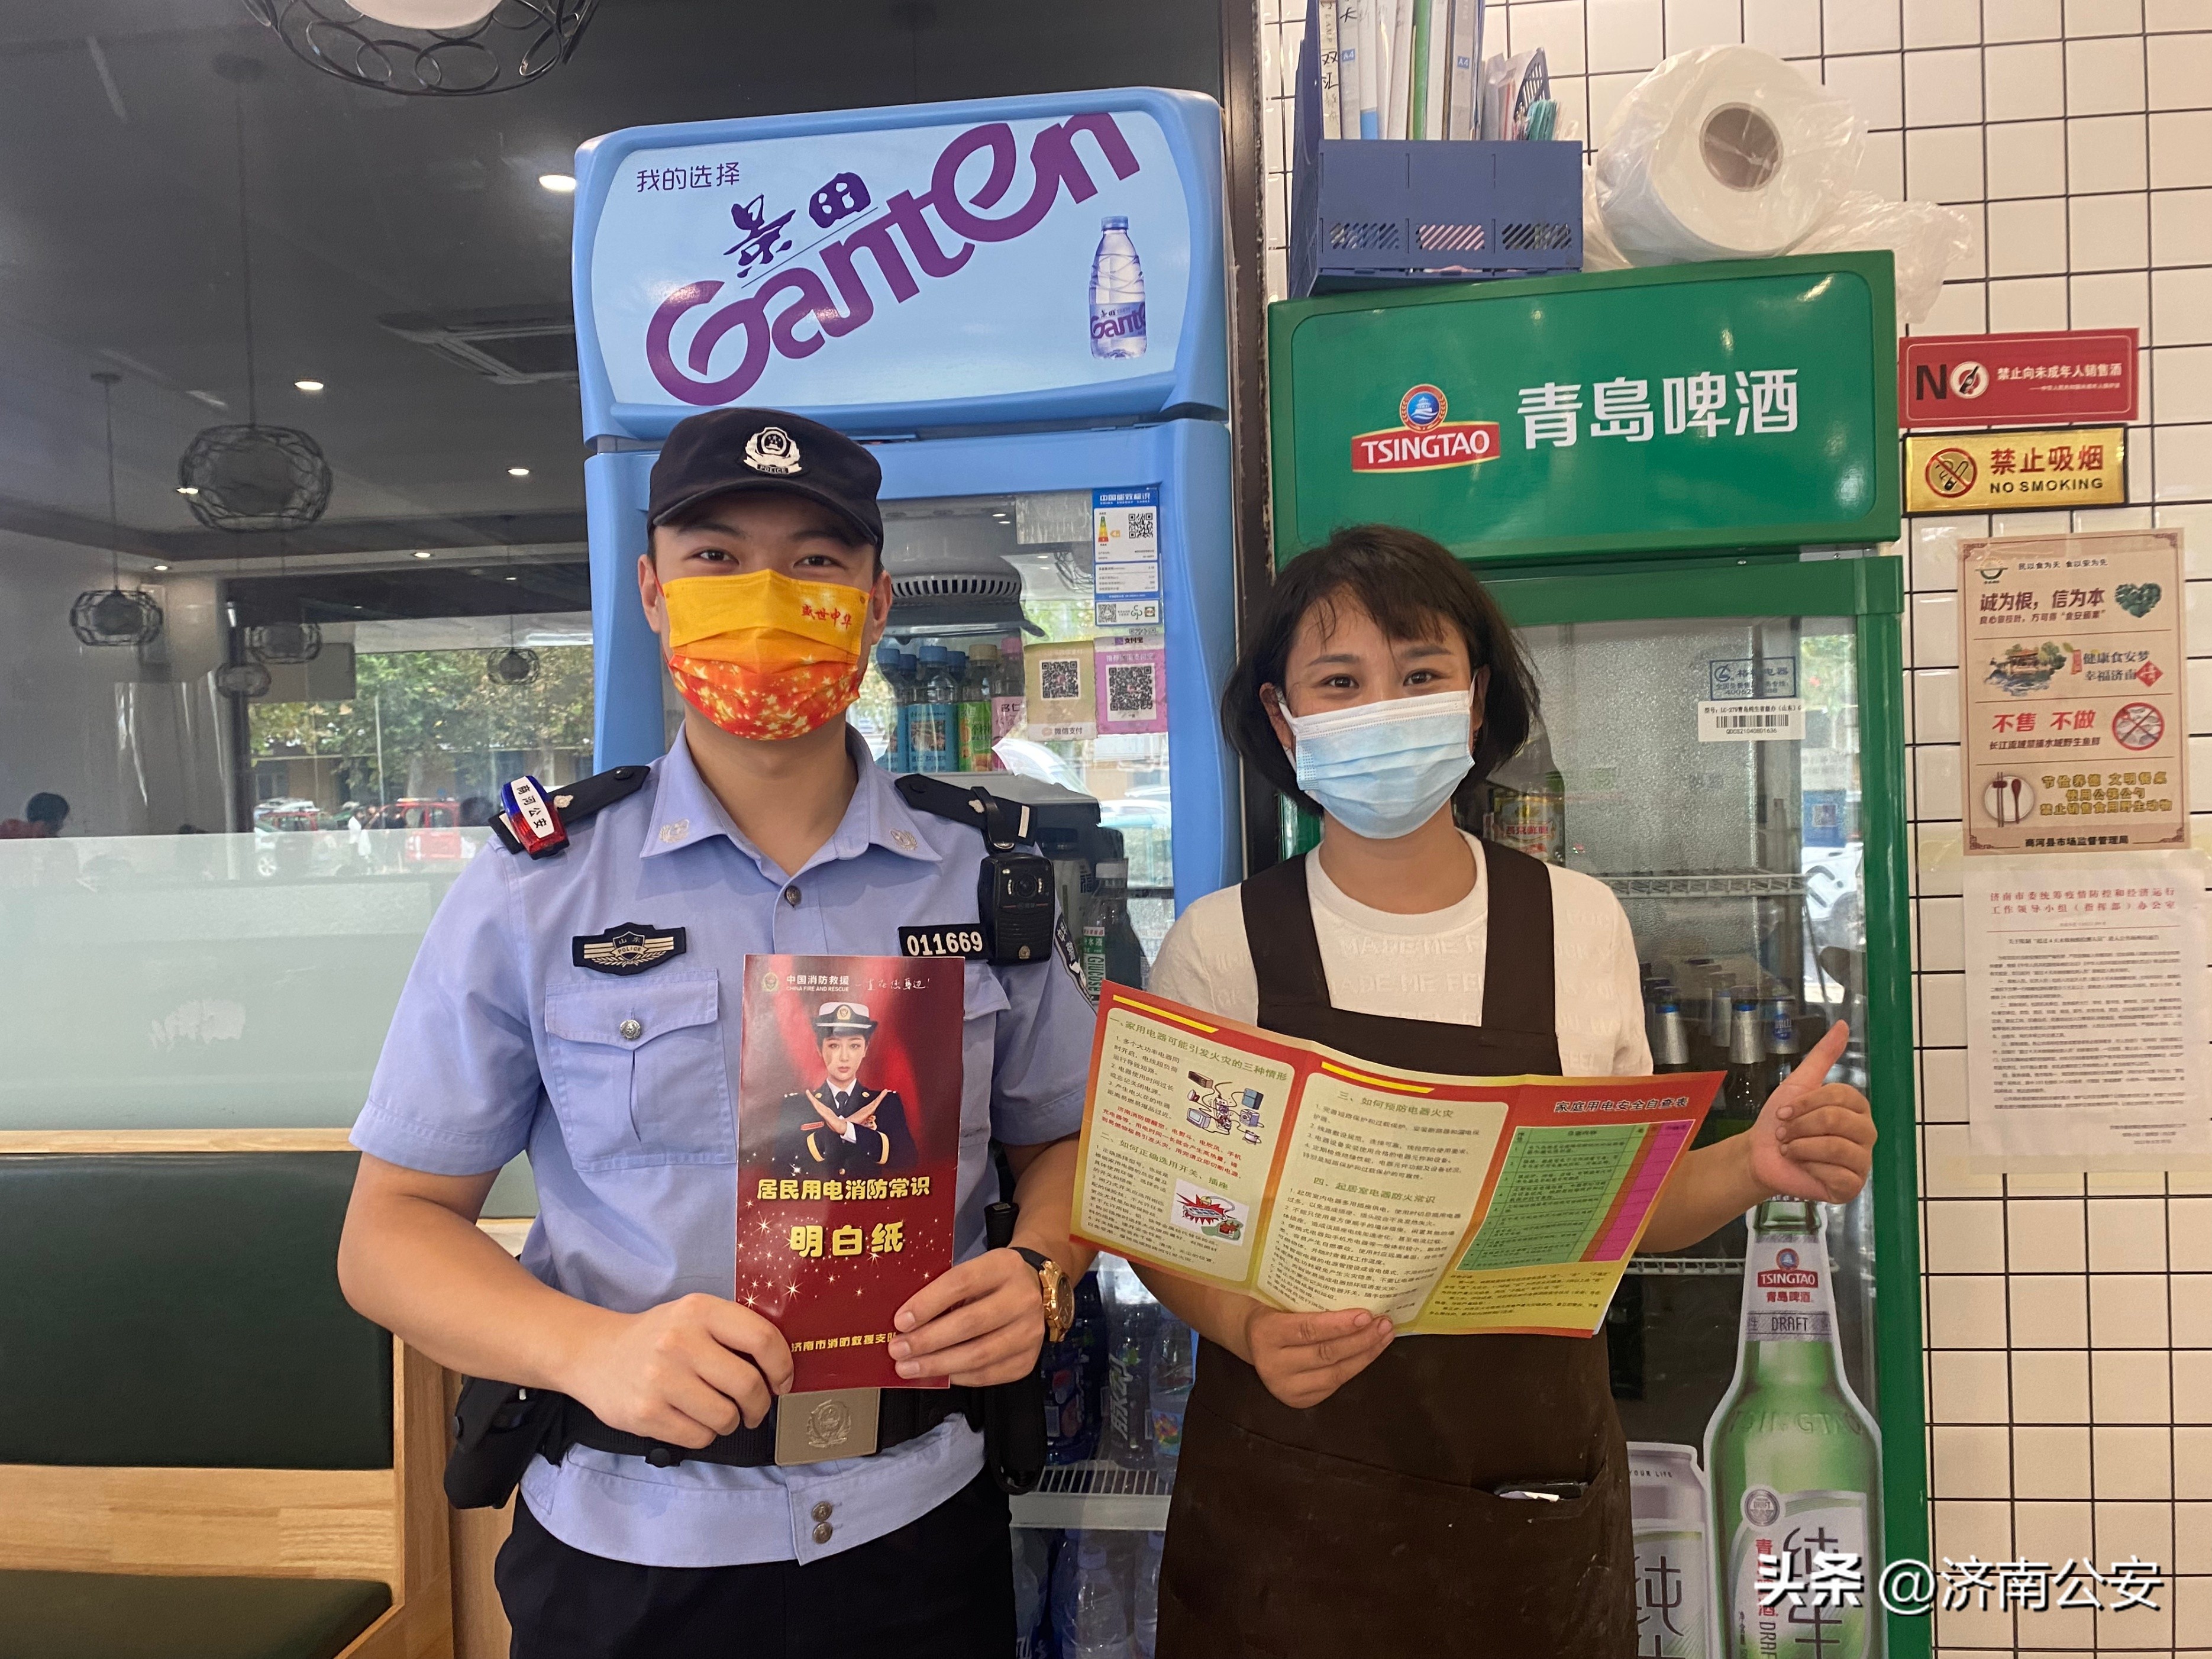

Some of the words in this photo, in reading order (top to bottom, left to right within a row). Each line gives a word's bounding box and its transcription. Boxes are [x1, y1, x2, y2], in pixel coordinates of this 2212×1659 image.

[1343, 50, 1355, 61] A4
[1458, 57, 1469, 67] A4
[637, 162, 741, 192] 我的选择
[723, 172, 871, 279] 景田
[645, 112, 1141, 406] Ganten
[1997, 363, 2122, 381] 禁止向未成年人销售酒
[1516, 368, 1799, 450] 青岛啤酒
[1360, 430, 1490, 464] TSINGTAO
[1991, 445, 2104, 476] 禁止吸烟
[1990, 482, 2014, 493] NO
[2020, 478, 2103, 492] SMOKING
[1980, 588, 2105, 611] 诚为根，信为本
[802, 603, 852, 628] 盛世中华
[2083, 651, 2150, 664] 健康食安梦
[1992, 713, 2036, 732] 不售
[2050, 710, 2095, 731] 不做
[2109, 771, 2167, 786] 文明餐桌
[2066, 787, 2145, 802] 使用公筷公勺
[516, 784, 547, 830] 商河公安
[2040, 799, 2173, 816] 禁止销售食用野生动物
[2025, 835, 2129, 847] 商河县市场监督管理局
[1991, 887, 2174, 902] 济南市委统筹疫情防控和经济运行
[1991, 900, 2176, 915] 工作领导小组（指挥部）办公室
[907, 931, 983, 956] 011669
[786, 975, 849, 985] 中国消防救援
[1109, 1014, 1287, 1082] 一、家用电器可能引发火灾的三种情形
[1113, 1053, 1158, 1076] 运行导致短路。
[1110, 1071, 1161, 1097] 或忘记关闭电源。
[1337, 1090, 1454, 1119] 三、如何预防电器火灾
[1554, 1097, 1690, 1112] 家庭用电安全自查表
[1100, 1131, 1228, 1190] 二、如何正确选用开关、插座
[757, 1177, 930, 1201] 居民用电消防常识
[1313, 1176, 1436, 1205] 四、起居室电器防火常识
[790, 1221, 904, 1257] 明白纸
[1761, 1273, 1816, 1285] TSINGTAO
[1772, 1317, 1808, 1331] DRAFT
